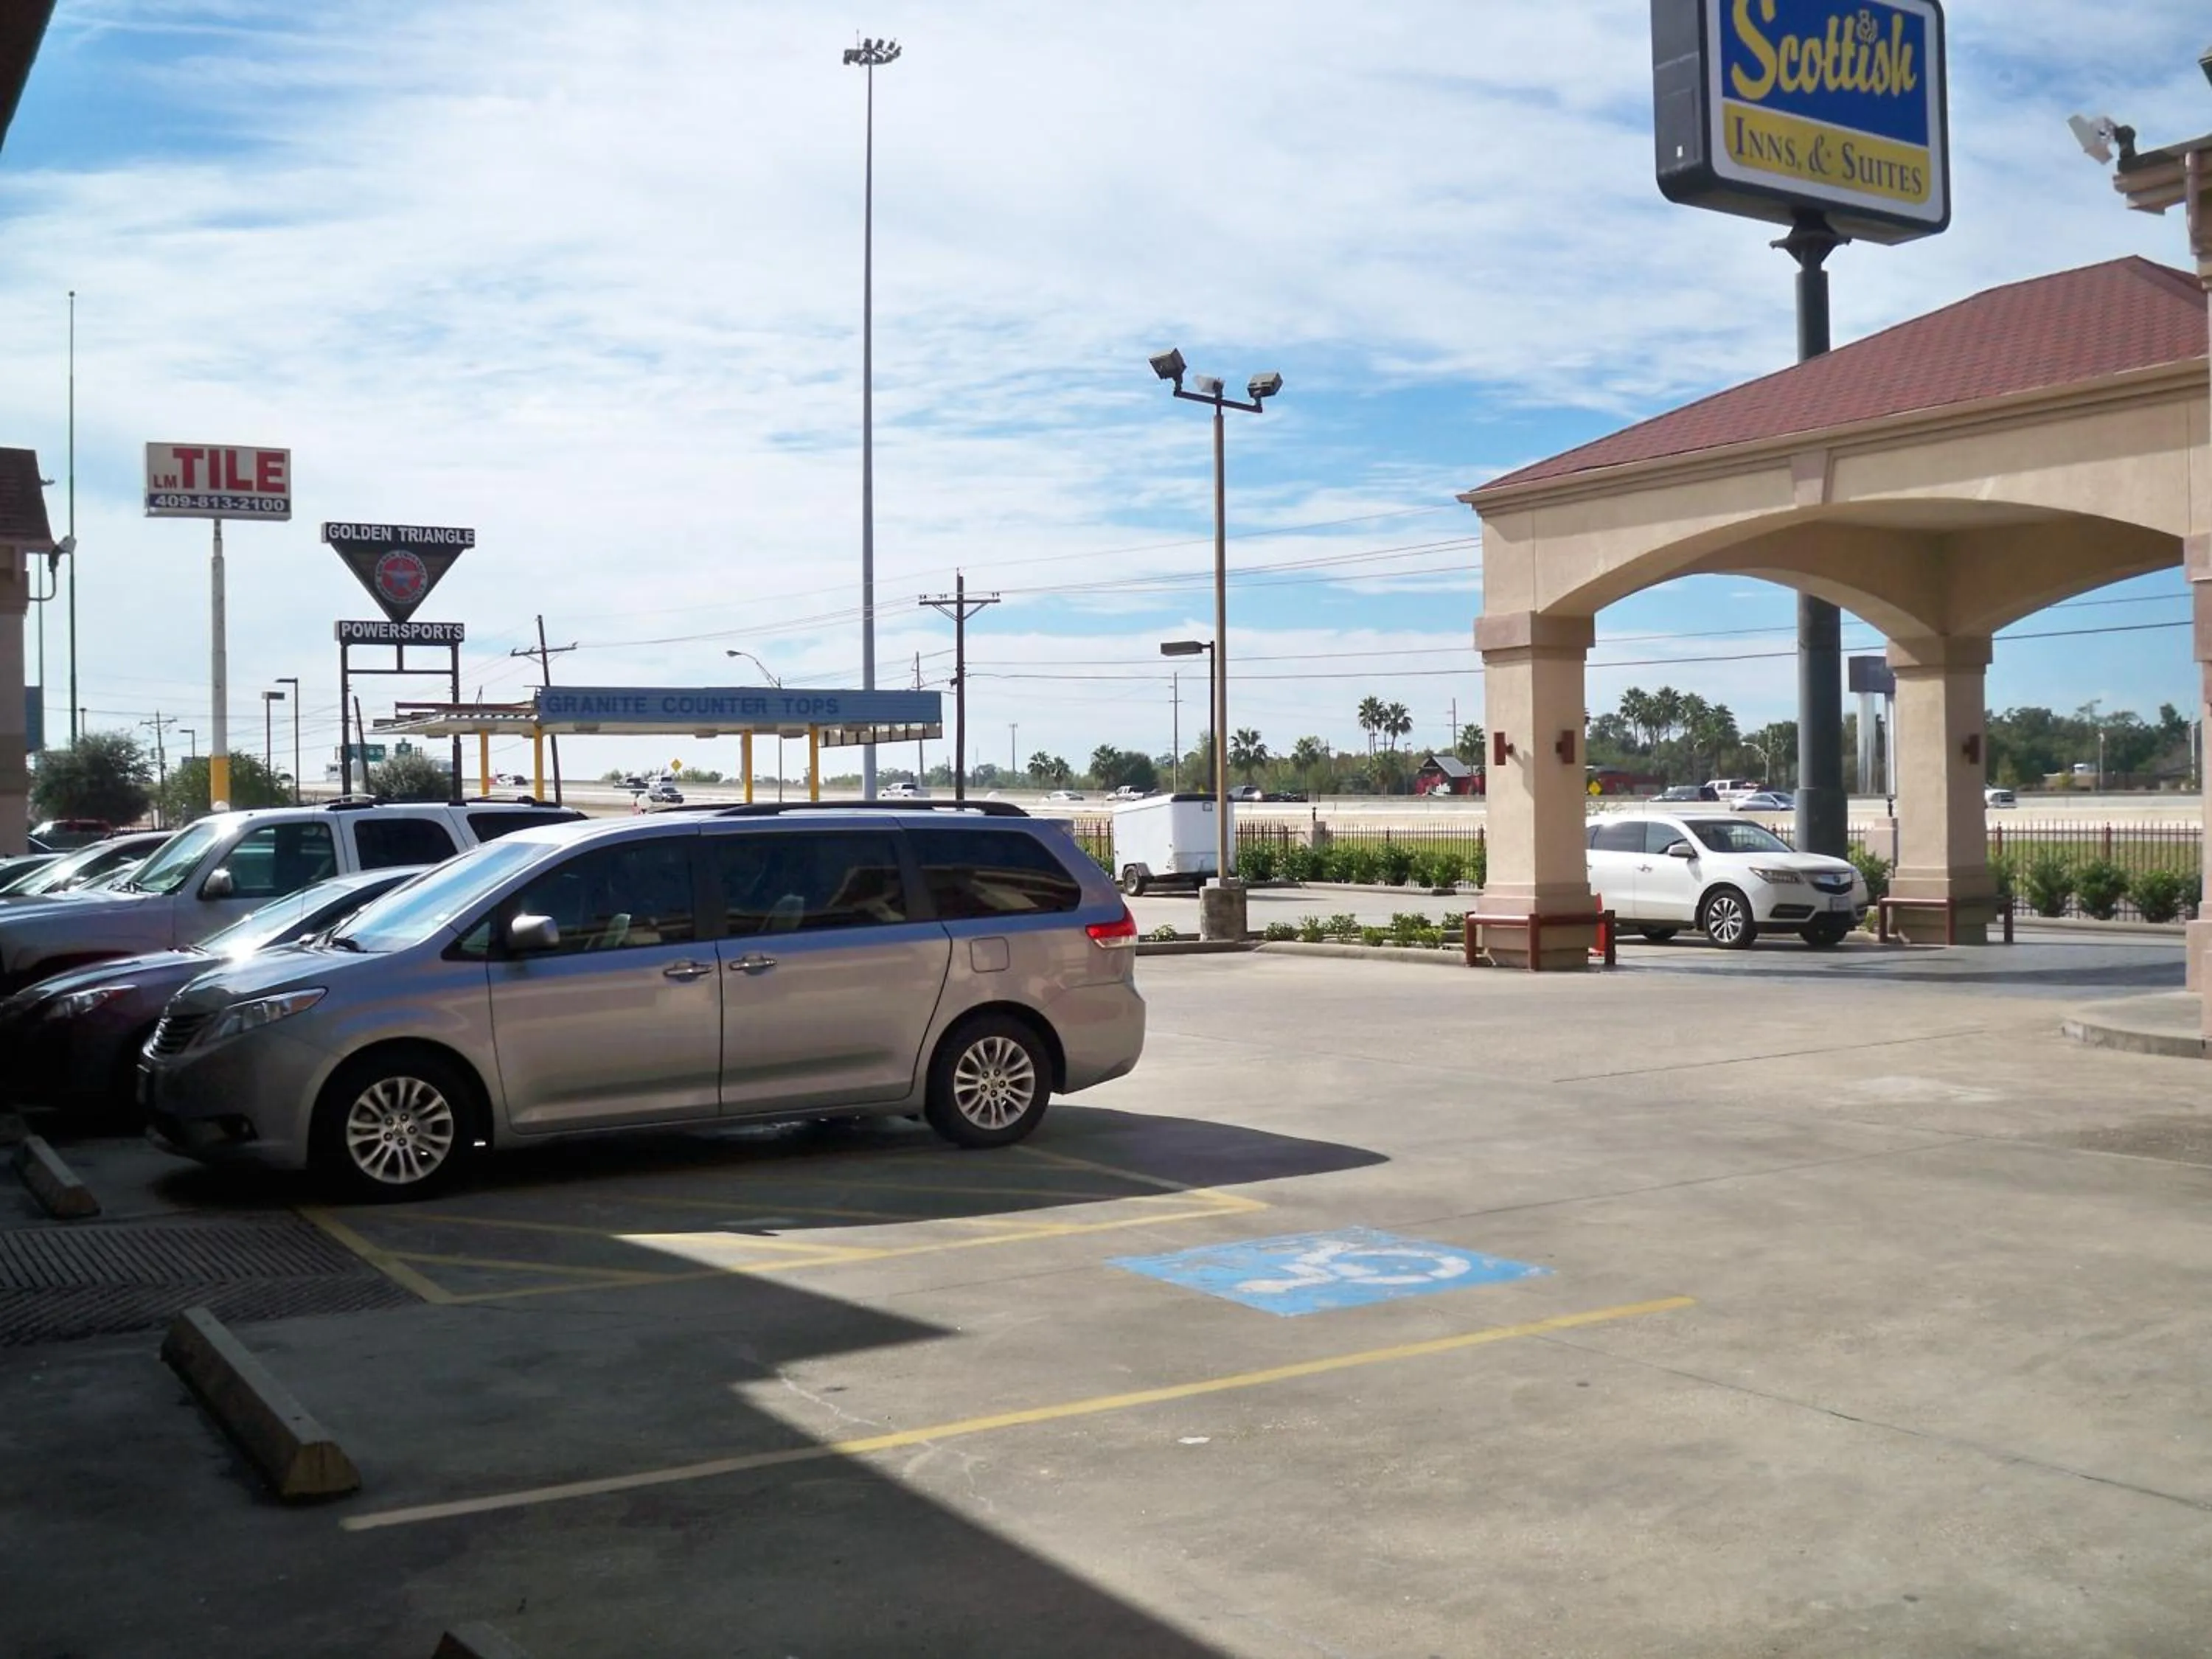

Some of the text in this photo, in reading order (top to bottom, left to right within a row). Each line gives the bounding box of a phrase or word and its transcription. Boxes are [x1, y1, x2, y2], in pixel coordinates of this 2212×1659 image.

[1731, 0, 1917, 101] Scottish
[1808, 133, 1830, 175] &
[1841, 141, 1922, 195] SUITES
[153, 448, 286, 493] LM TILE
[154, 495, 285, 511] 409-813-2100
[328, 524, 475, 544] GOLDEN TRIANGLE
[341, 623, 464, 639] POWERSPORTS
[546, 695, 840, 715] GRANITE COUNTER TOPS
